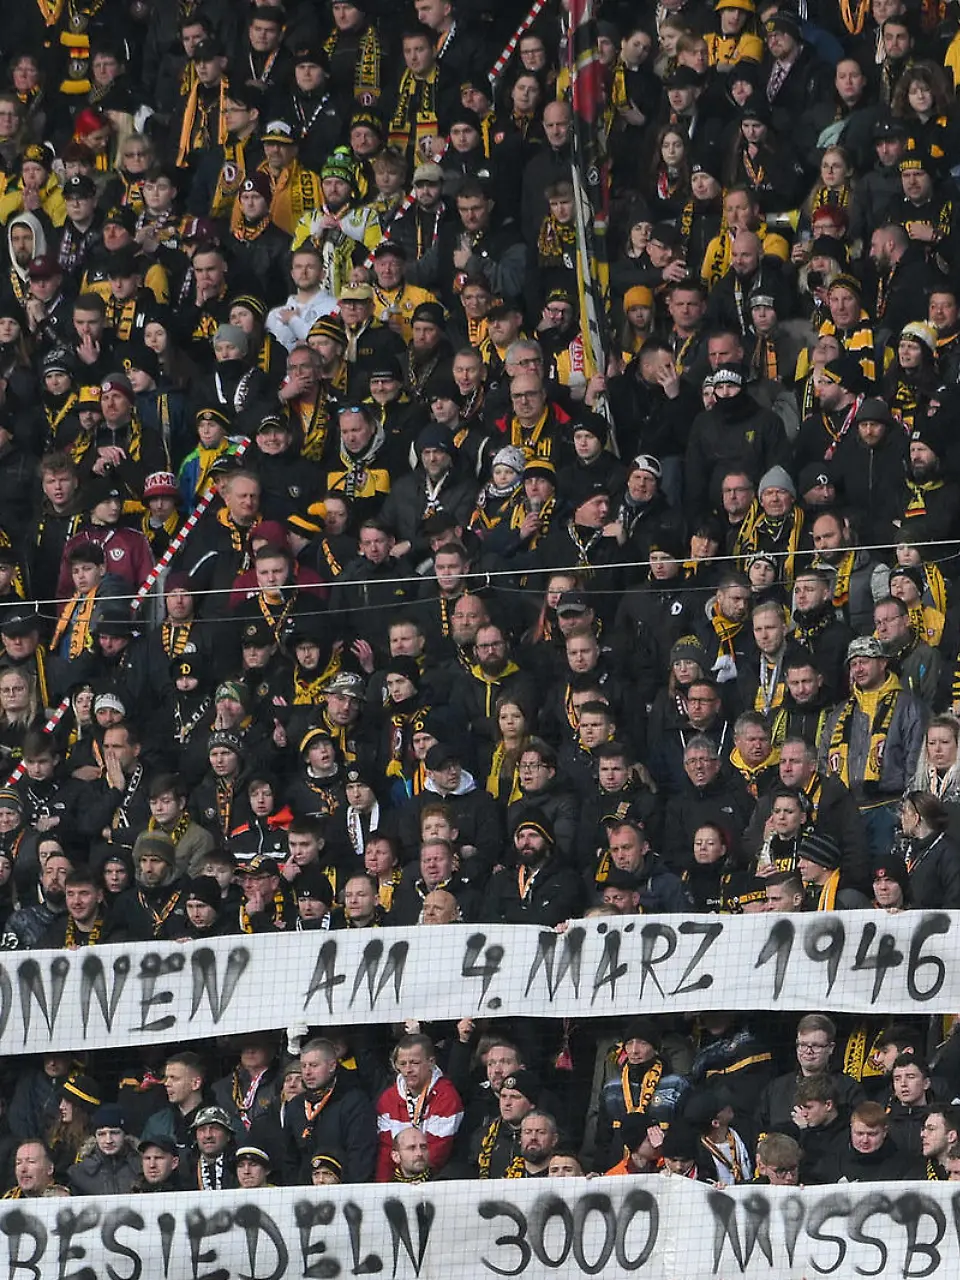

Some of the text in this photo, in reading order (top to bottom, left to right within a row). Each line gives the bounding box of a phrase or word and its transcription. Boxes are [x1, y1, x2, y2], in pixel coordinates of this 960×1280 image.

[303, 939, 410, 1012] AM
[524, 920, 724, 1003] MÄRZ
[754, 912, 953, 1006] 1946
[477, 1187, 659, 1277] 3000
